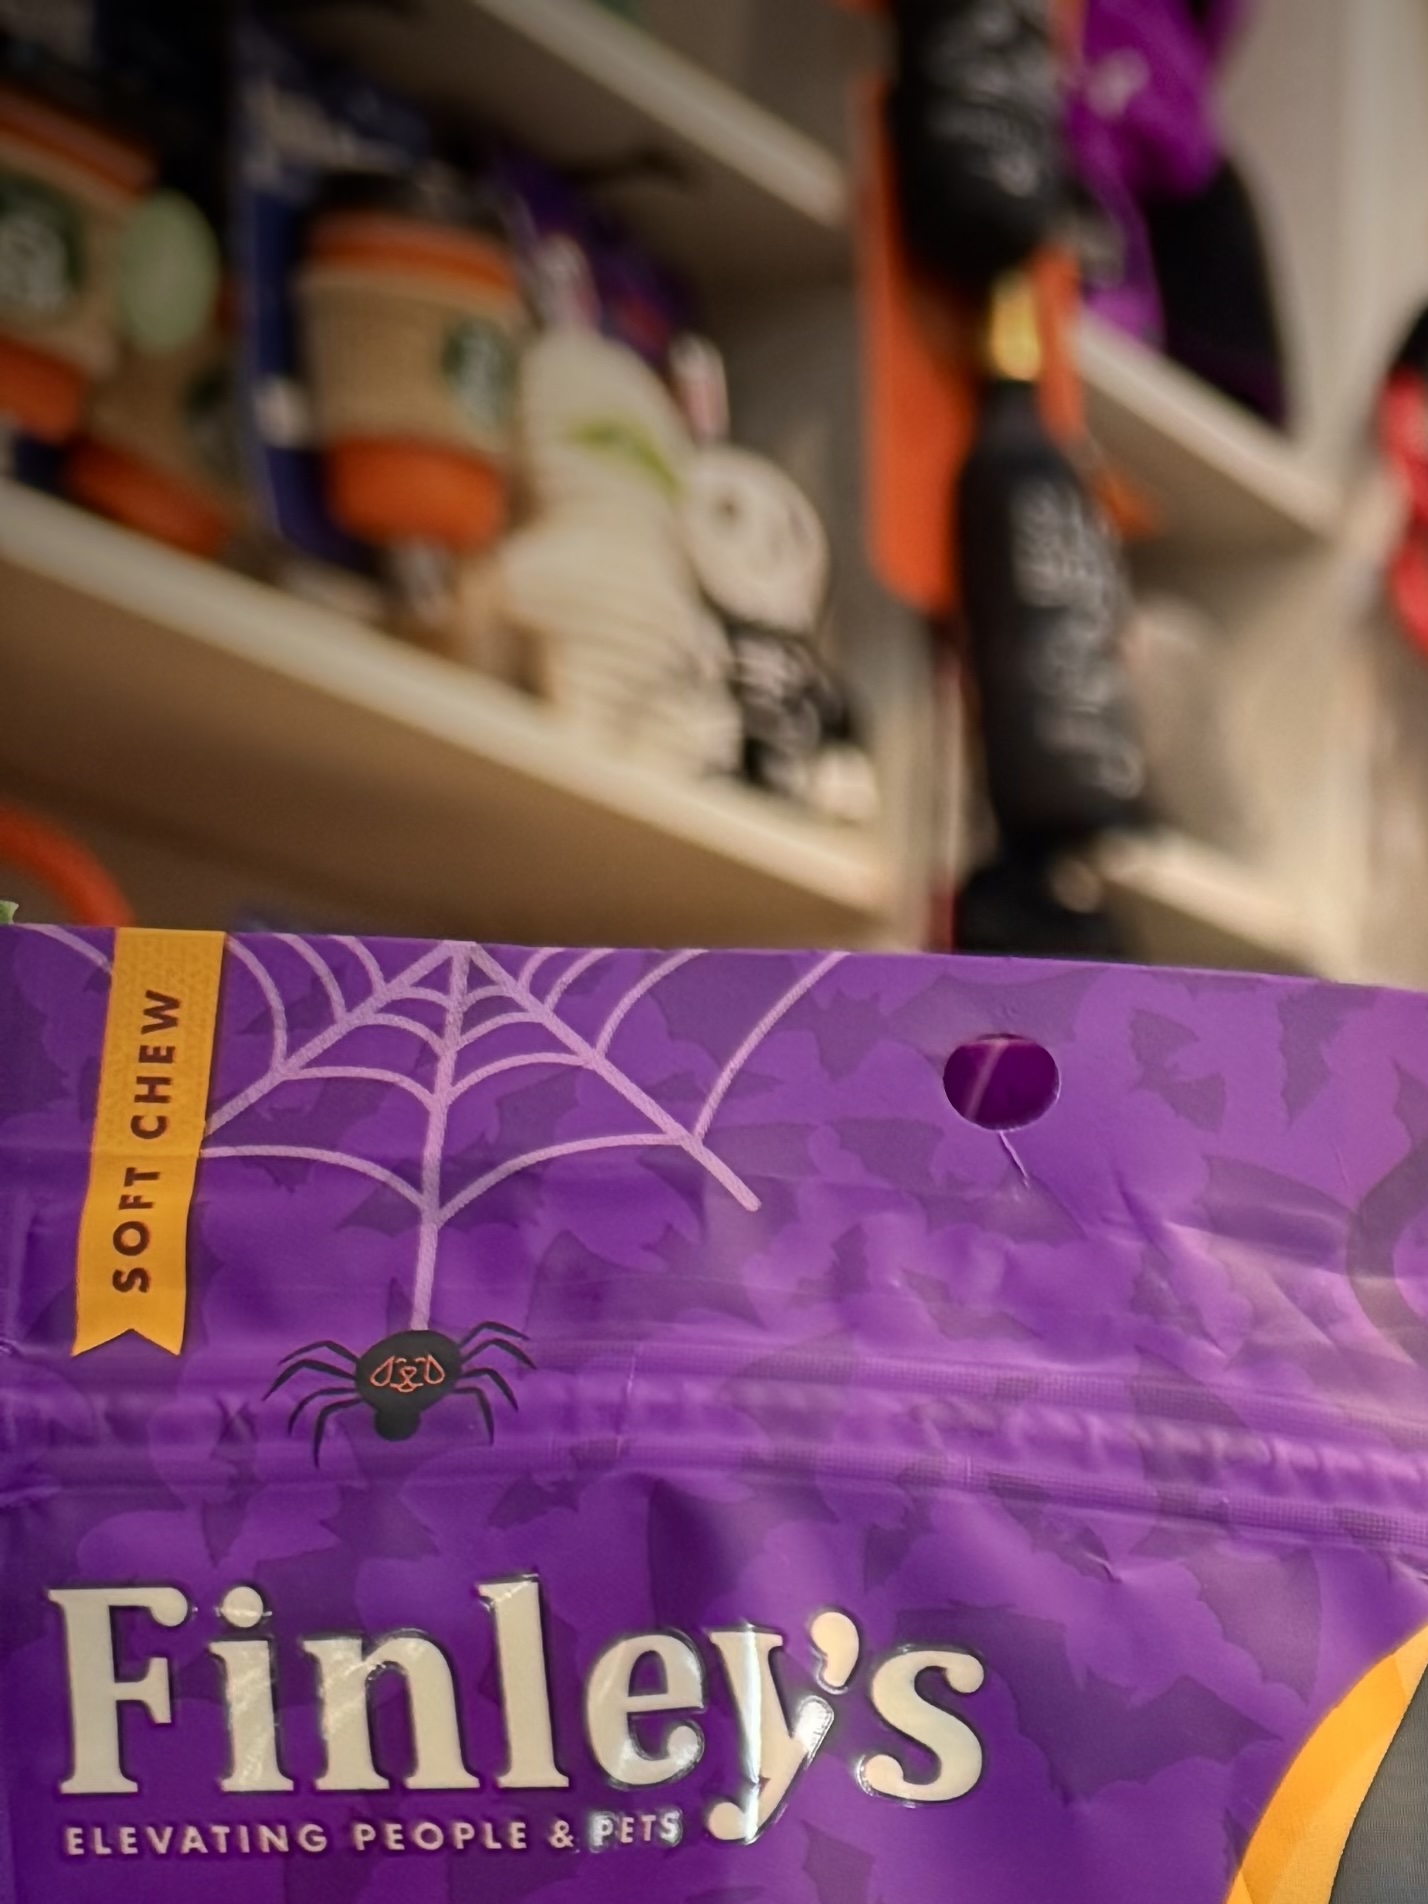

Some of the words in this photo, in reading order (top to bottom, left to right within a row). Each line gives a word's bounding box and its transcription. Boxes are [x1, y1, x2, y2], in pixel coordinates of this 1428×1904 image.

[130, 989, 180, 1139] CHEW
[112, 1167, 160, 1293] SOFT
[47, 1573, 984, 1844] Finley's
[66, 1823, 328, 1856] ELEVATING
[354, 1821, 527, 1852] PEOPLE
[549, 1819, 574, 1849] &
[590, 1811, 682, 1852] PETS
